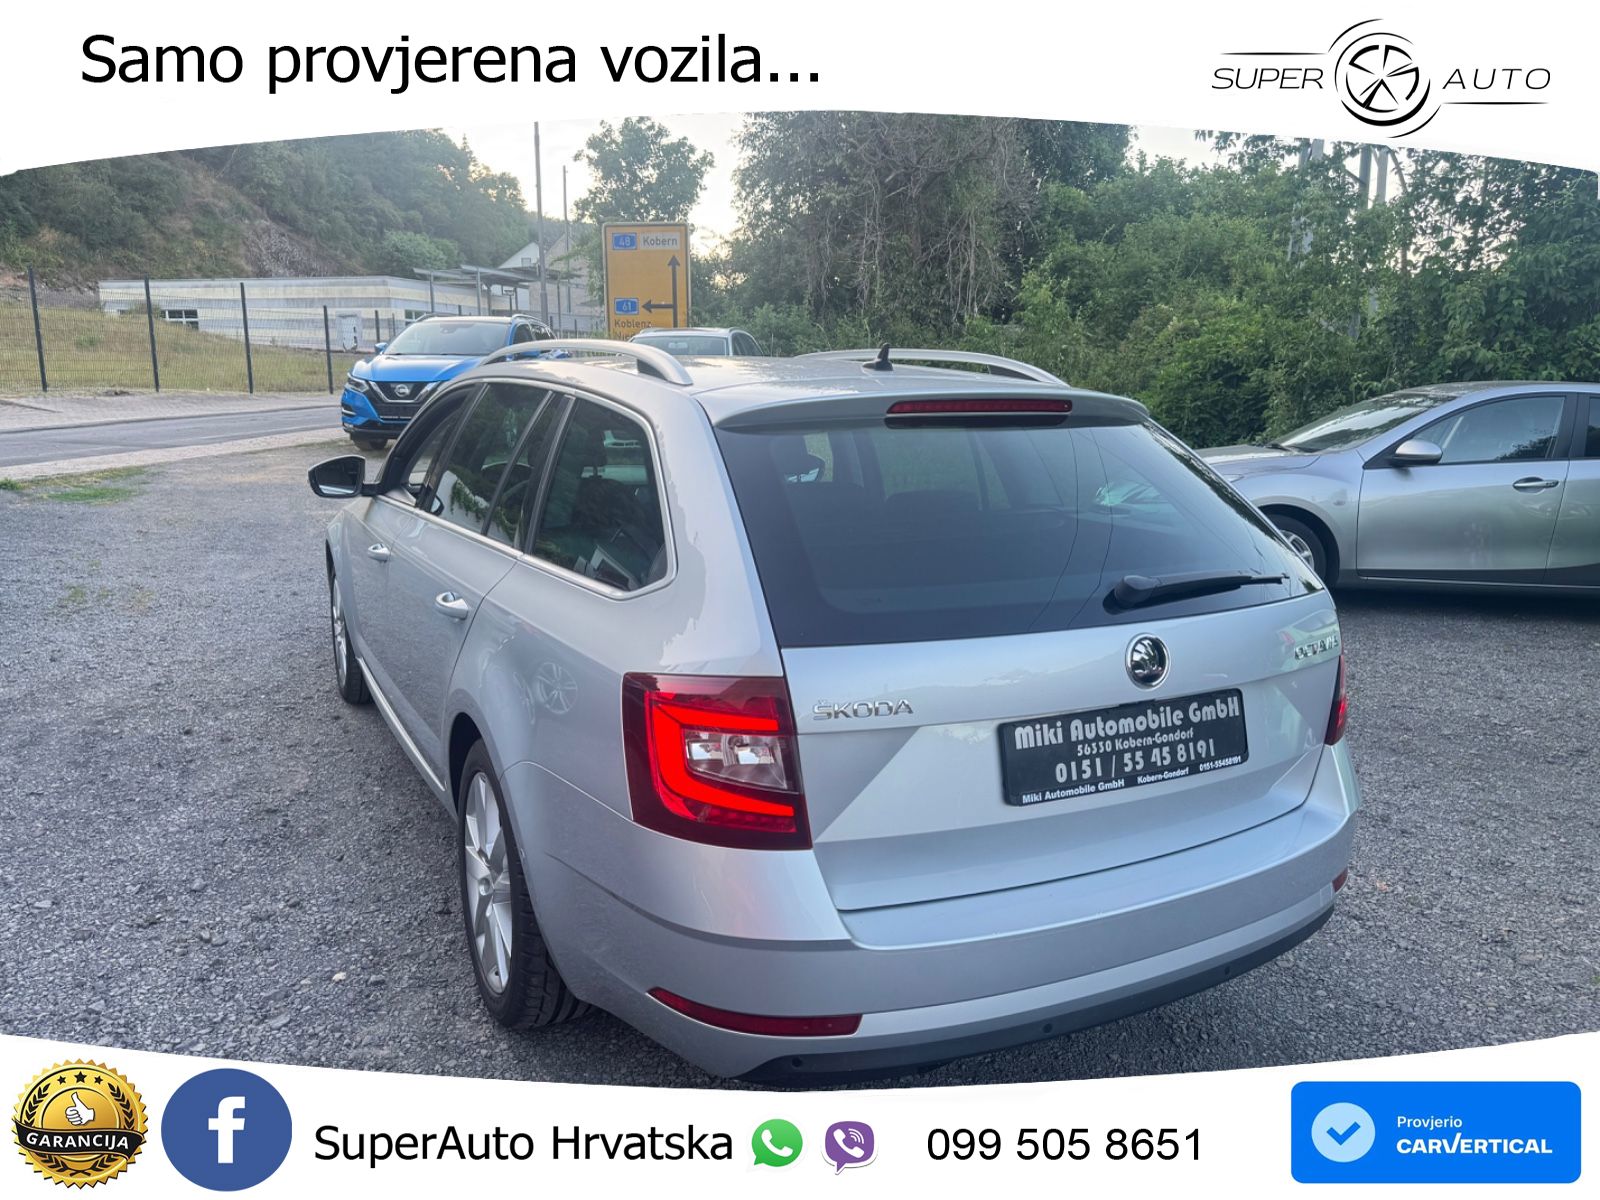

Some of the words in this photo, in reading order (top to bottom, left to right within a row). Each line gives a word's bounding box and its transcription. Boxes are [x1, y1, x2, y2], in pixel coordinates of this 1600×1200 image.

[618, 236, 631, 246] 48
[642, 235, 678, 246] Kobern
[622, 302, 632, 311] 61
[614, 319, 652, 329] Koblenz
[1014, 721, 1064, 750] Miki
[1070, 705, 1184, 742] Automobile
[1188, 696, 1240, 723] GmbH
[1115, 727, 1194, 752] Kobern-Gondorf
[1055, 757, 1103, 784] 0151
[1111, 755, 1116, 778] /
[1123, 749, 1145, 773] 55
[1150, 744, 1172, 767] 45
[1177, 739, 1216, 764] 8191
[1022, 792, 1042, 805] Miki
[1045, 784, 1096, 801] Automobile
[1098, 778, 1125, 793] GmbH
[1137, 766, 1190, 785] Kobern-Gondorf
